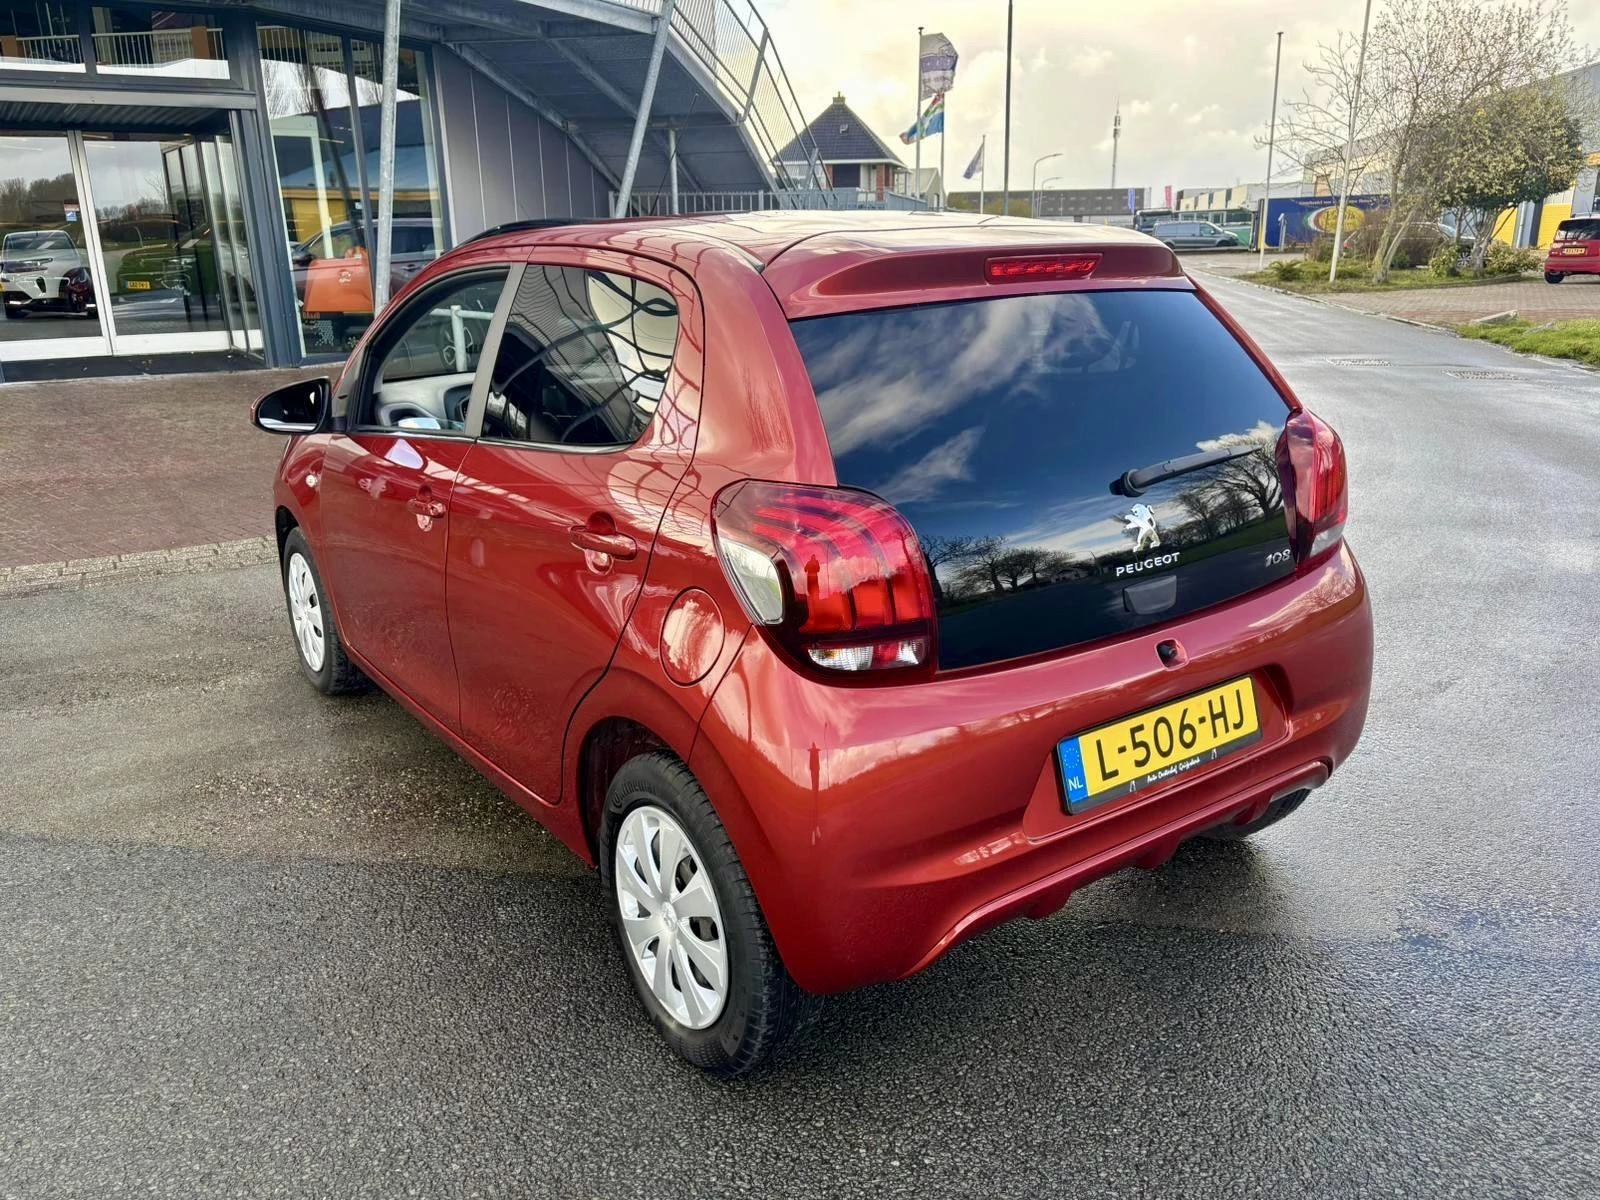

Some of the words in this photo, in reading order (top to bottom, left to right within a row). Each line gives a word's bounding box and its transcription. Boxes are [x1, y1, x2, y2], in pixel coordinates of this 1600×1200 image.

[1116, 552, 1180, 577] PEUGEOT
[1265, 549, 1291, 568] 108
[1096, 689, 1244, 782] L-506-HJ
[1068, 776, 1083, 791] NL
